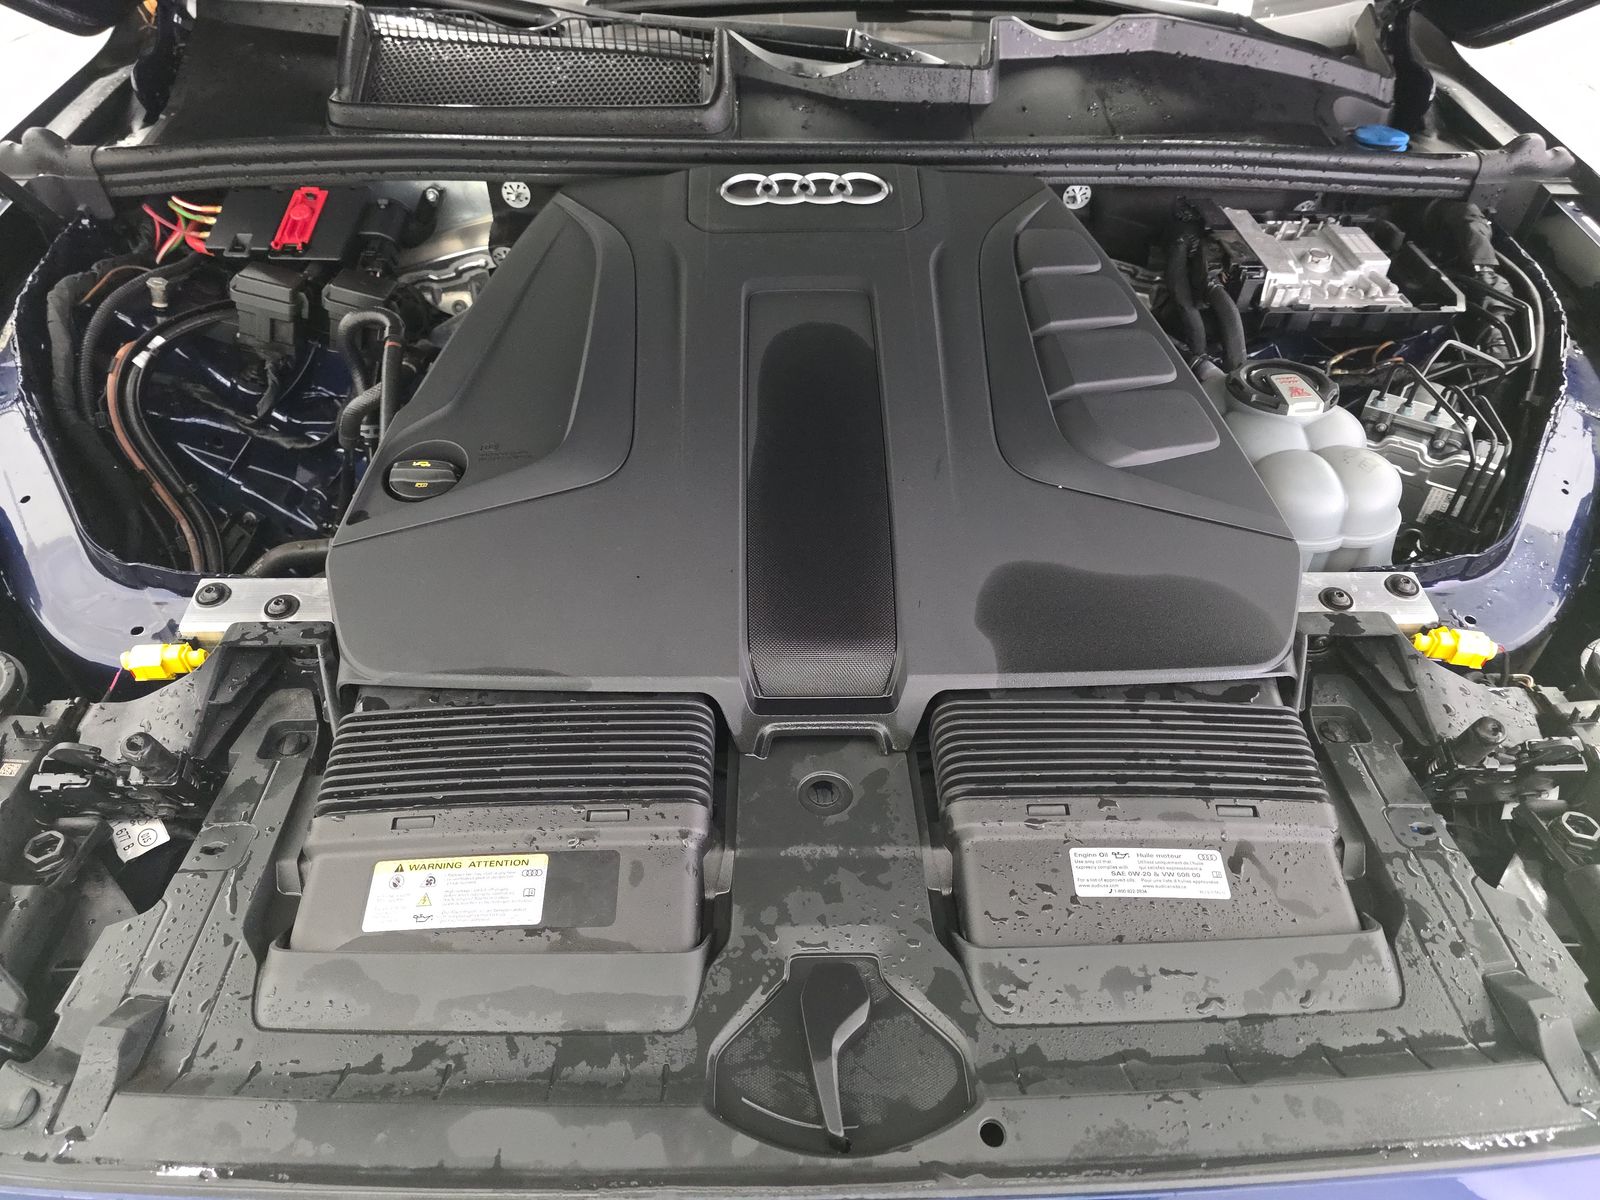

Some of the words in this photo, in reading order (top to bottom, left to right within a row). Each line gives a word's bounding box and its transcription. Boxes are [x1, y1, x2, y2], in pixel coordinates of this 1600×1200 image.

[116, 828, 131, 842] 677
[408, 862, 462, 871] WARNING
[468, 858, 530, 868] ATTENTION
